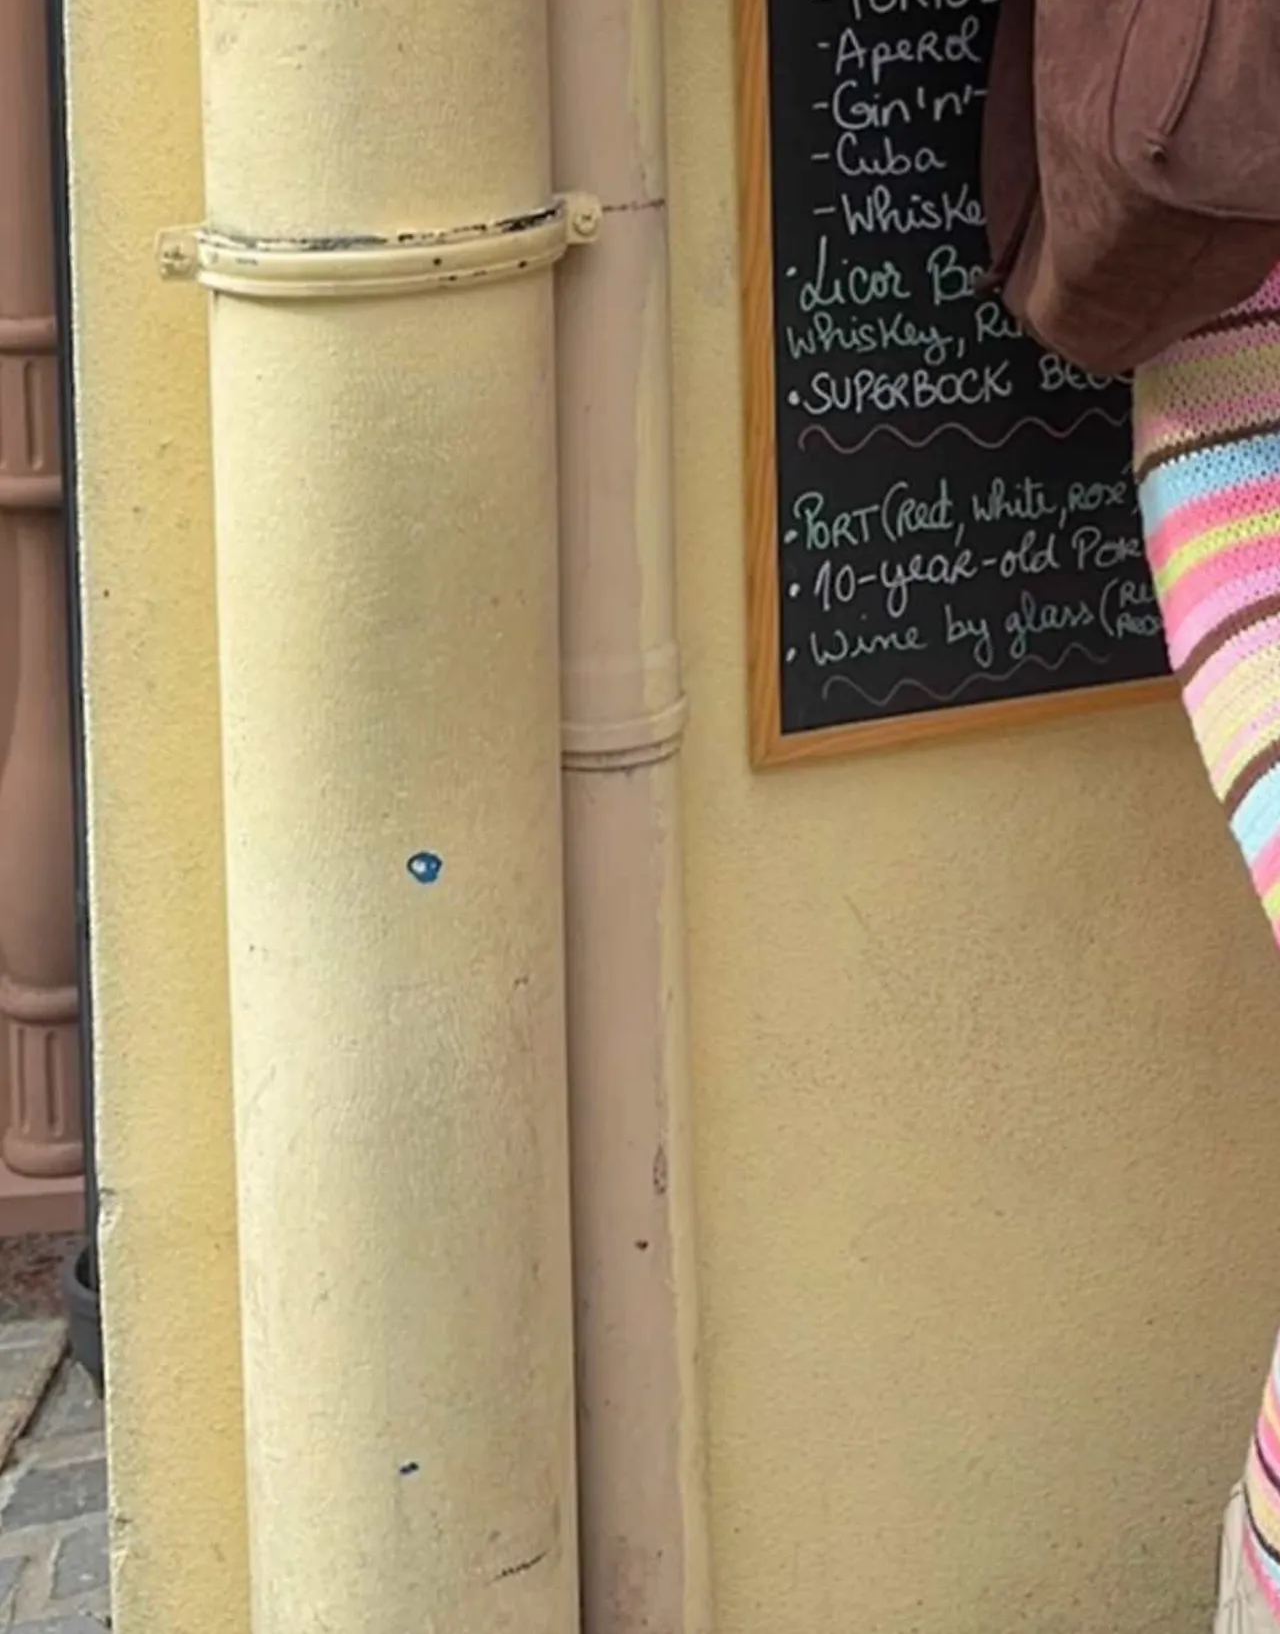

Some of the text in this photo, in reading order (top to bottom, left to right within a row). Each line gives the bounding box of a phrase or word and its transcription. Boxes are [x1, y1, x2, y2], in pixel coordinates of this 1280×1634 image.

[836, 131, 947, 175] Cuba
[841, 183, 988, 235] Whiske
[975, 301, 1023, 343] Ru
[811, 613, 927, 665] Wine
[945, 604, 993, 667] by
